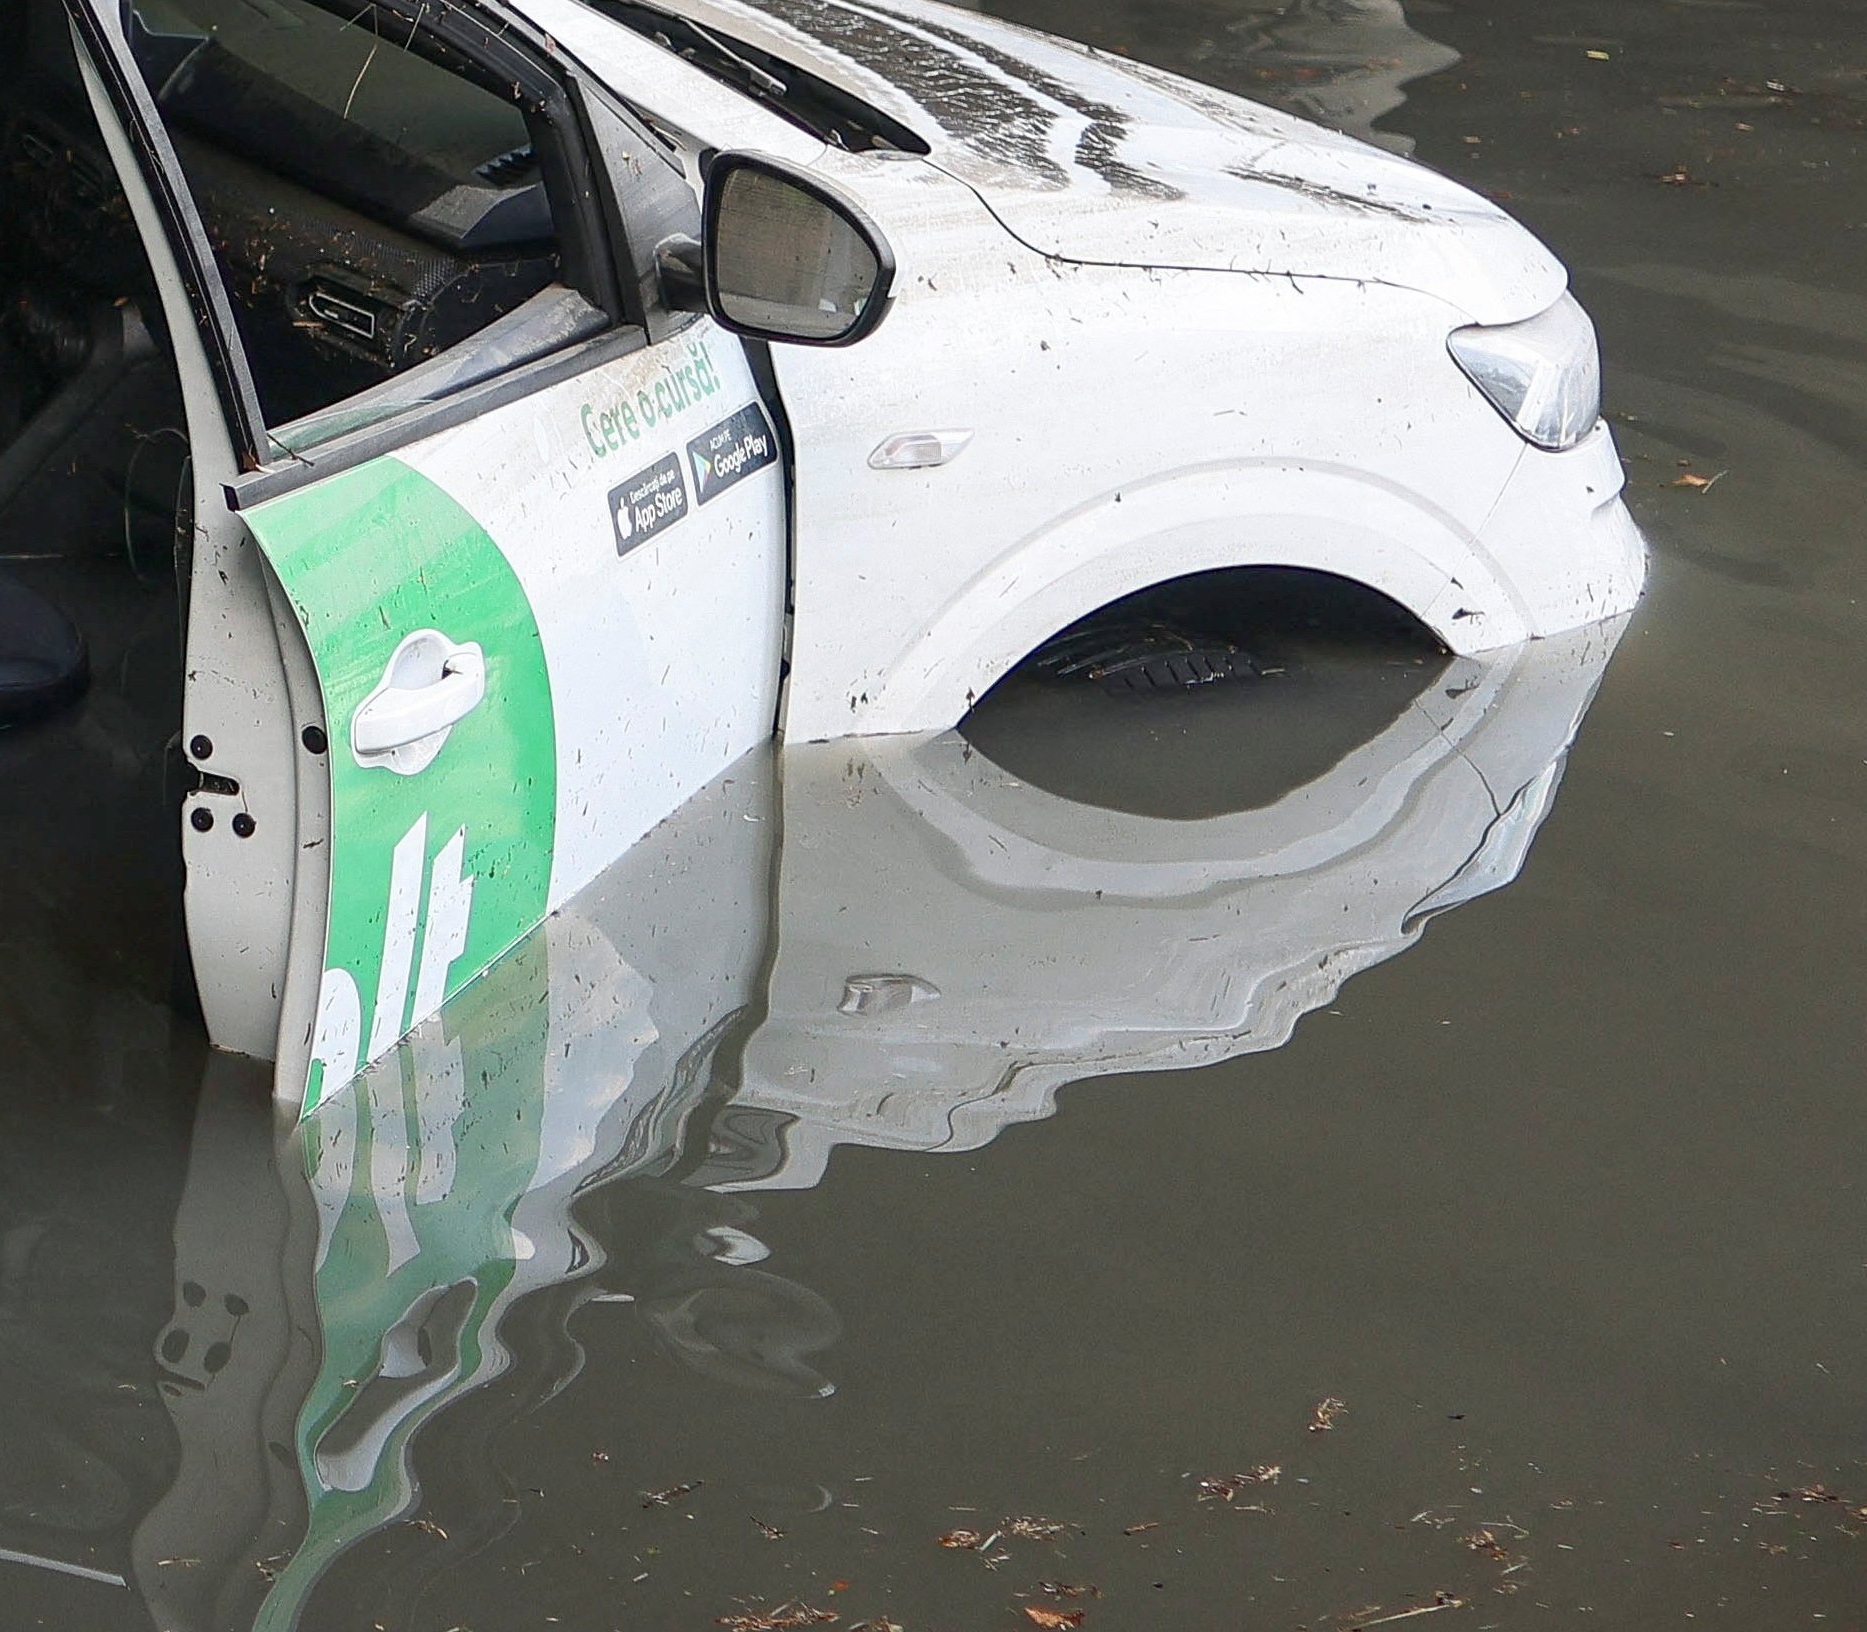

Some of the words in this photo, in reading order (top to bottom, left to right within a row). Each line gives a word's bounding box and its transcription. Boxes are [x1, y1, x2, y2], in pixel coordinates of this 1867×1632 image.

[580, 400, 641, 458] Cere
[636, 390, 658, 428] o
[653, 340, 722, 418] cursă!
[713, 442, 747, 478] Google
[743, 433, 768, 458] Play
[634, 505, 656, 533] App
[654, 487, 683, 518] Store
